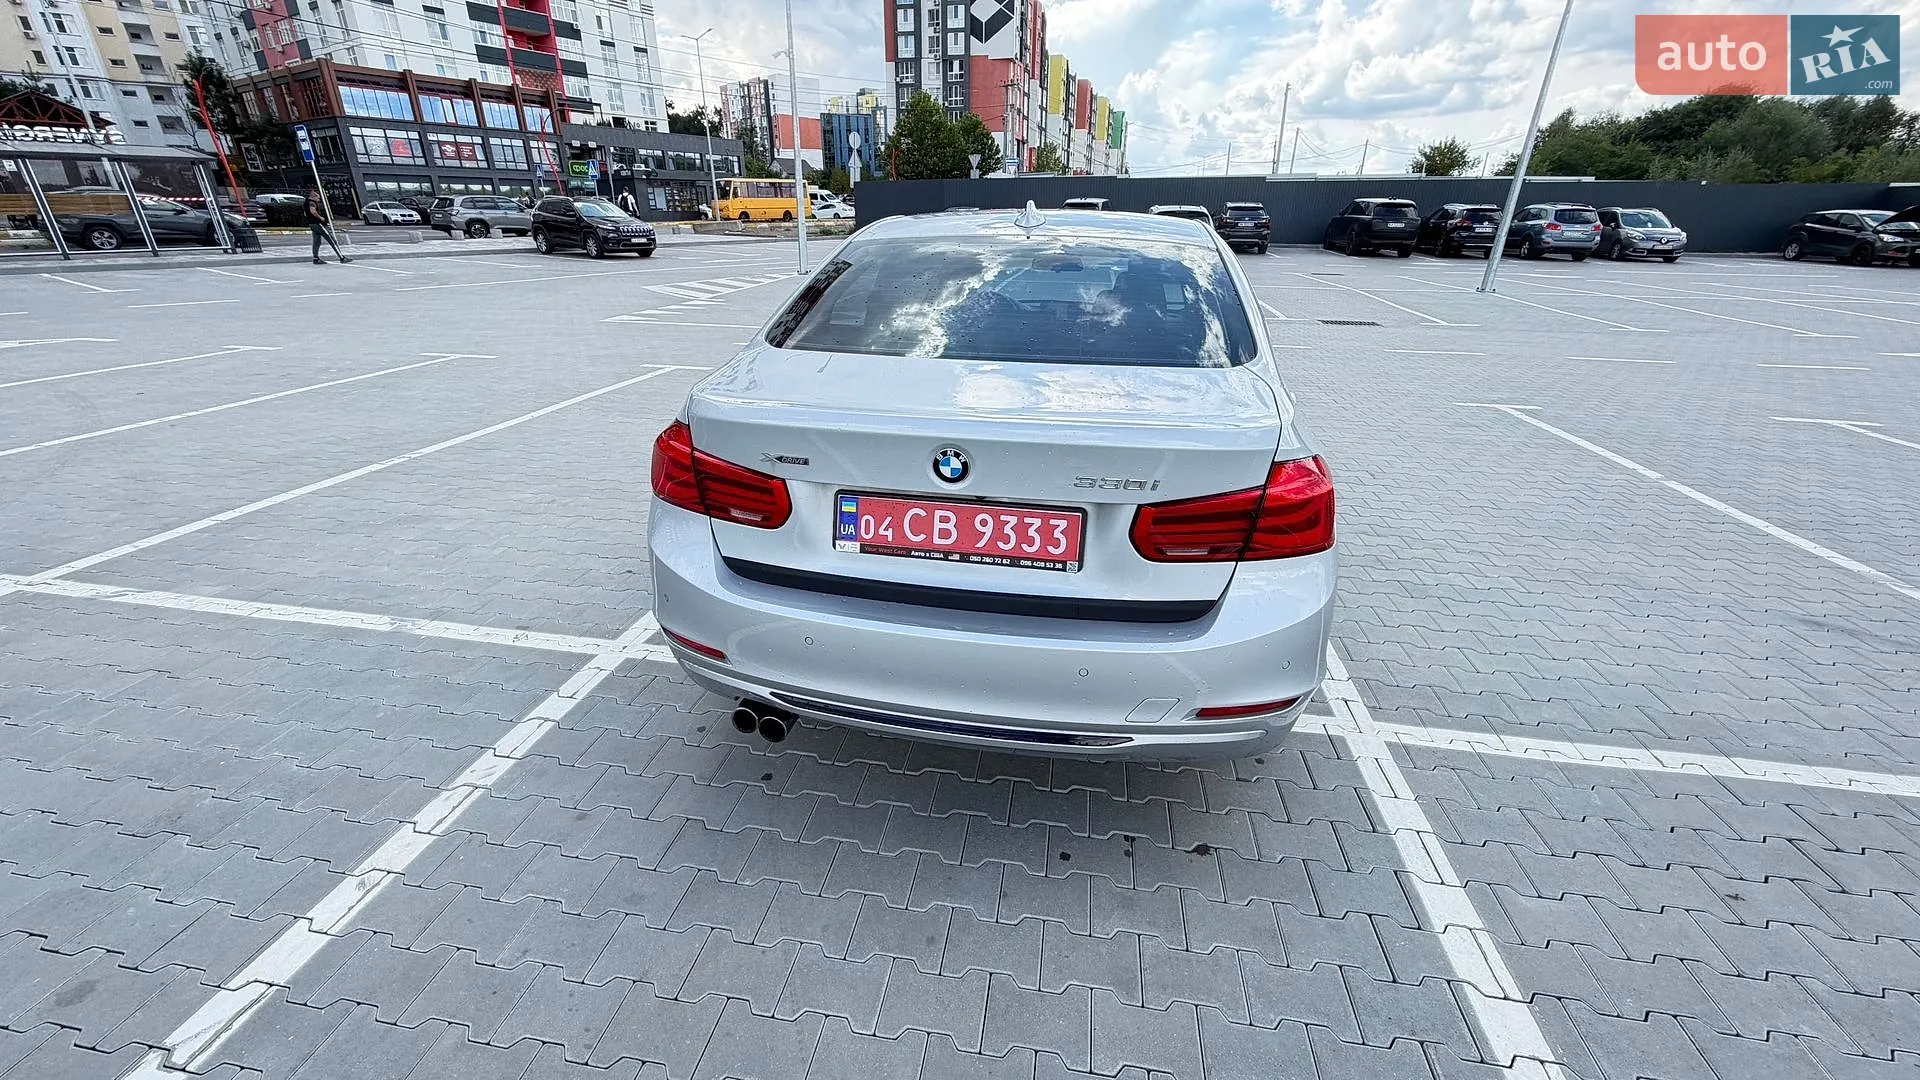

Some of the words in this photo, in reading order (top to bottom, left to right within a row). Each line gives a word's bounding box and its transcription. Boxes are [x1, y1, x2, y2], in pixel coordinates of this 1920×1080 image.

[936, 450, 966, 463] BMW
[1073, 475, 1161, 491] 330i
[840, 523, 856, 536] UA
[860, 514, 893, 542] 04
[903, 507, 958, 545] CB
[974, 513, 1068, 555] 9333
